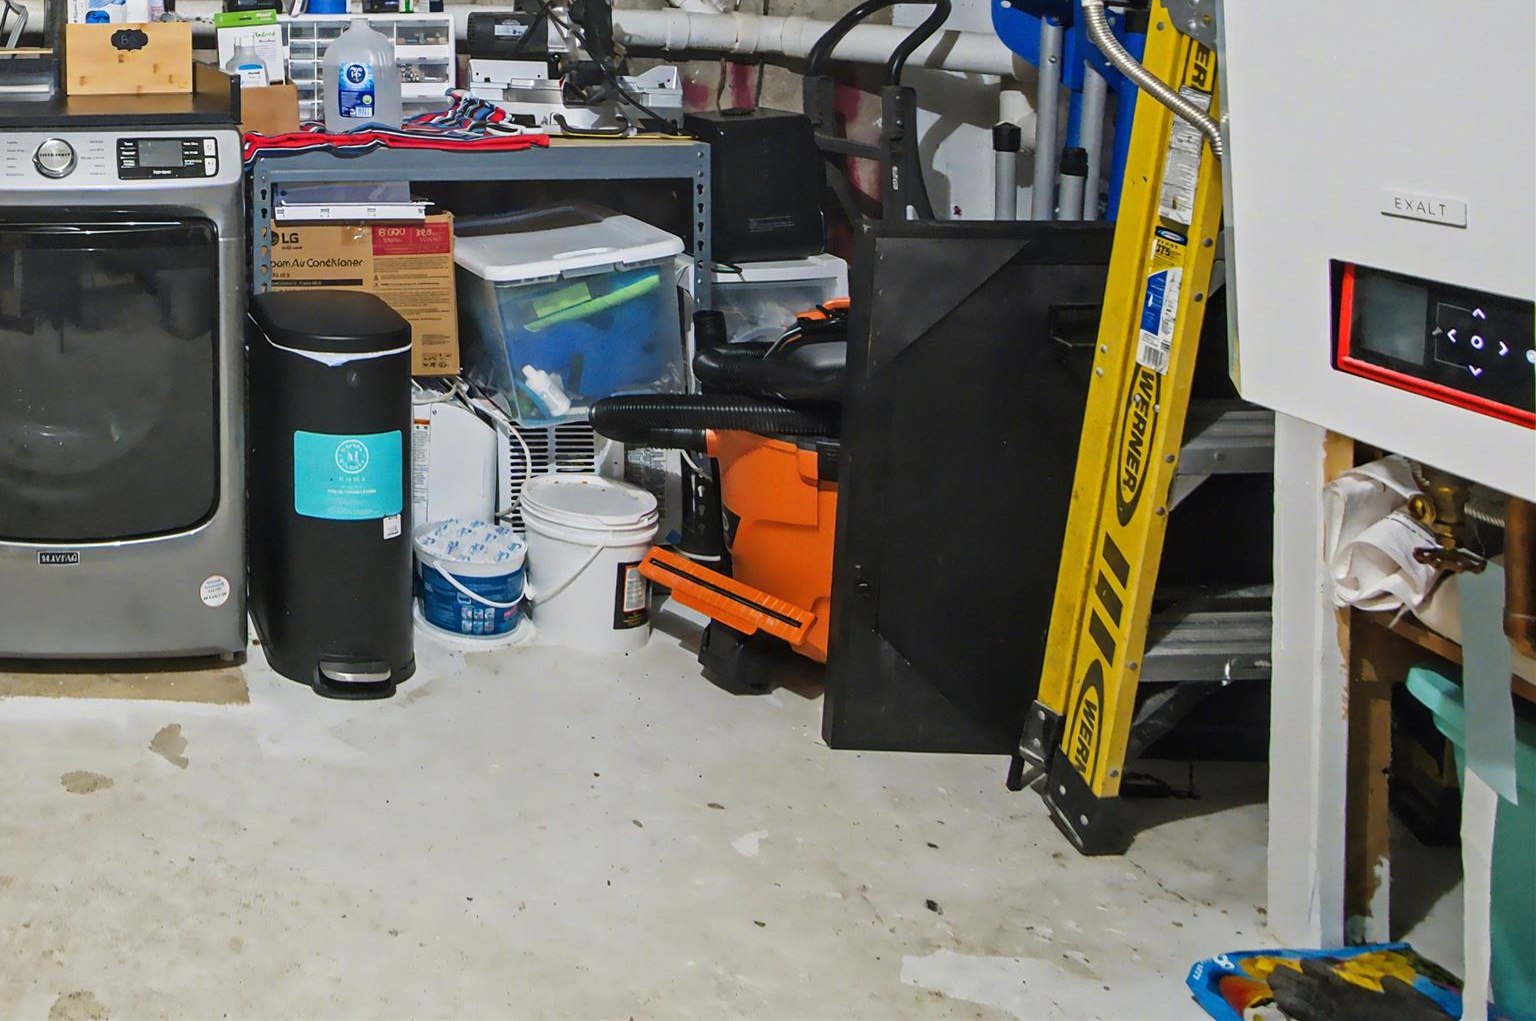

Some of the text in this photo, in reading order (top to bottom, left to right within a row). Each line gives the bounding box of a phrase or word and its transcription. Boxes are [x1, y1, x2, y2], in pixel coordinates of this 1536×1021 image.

[1394, 196, 1447, 217] EXALT
[281, 232, 299, 244] LG
[1122, 368, 1156, 495] WERNER
[1075, 697, 1098, 774] WERN
